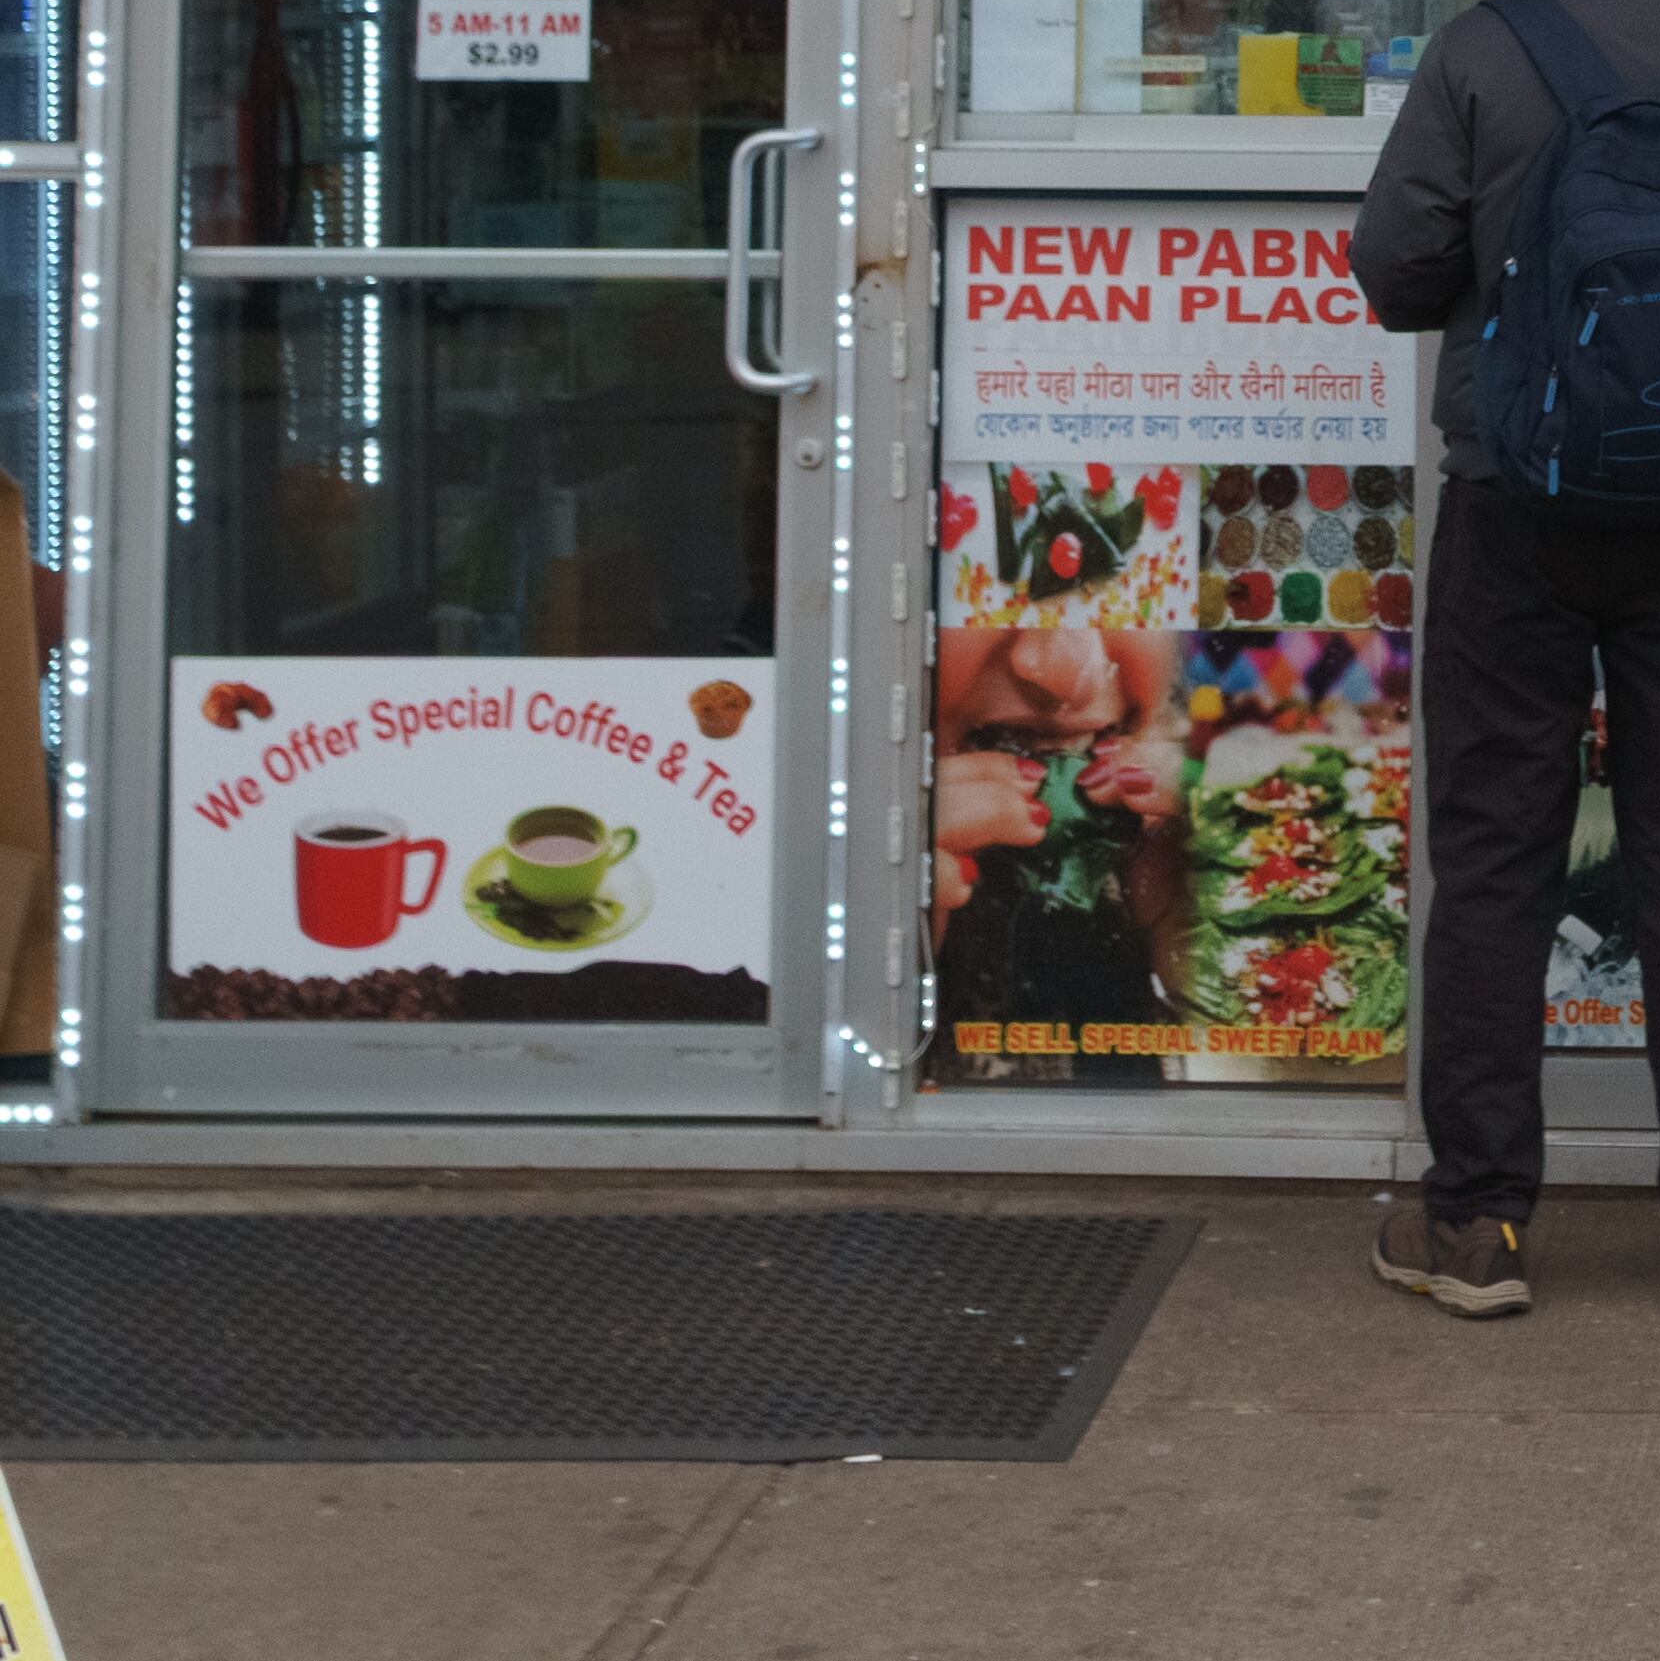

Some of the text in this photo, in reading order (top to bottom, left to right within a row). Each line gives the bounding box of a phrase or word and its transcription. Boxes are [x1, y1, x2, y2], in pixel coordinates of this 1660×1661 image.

[193, 685, 760, 837] We Offer Special Coffee & Tea
